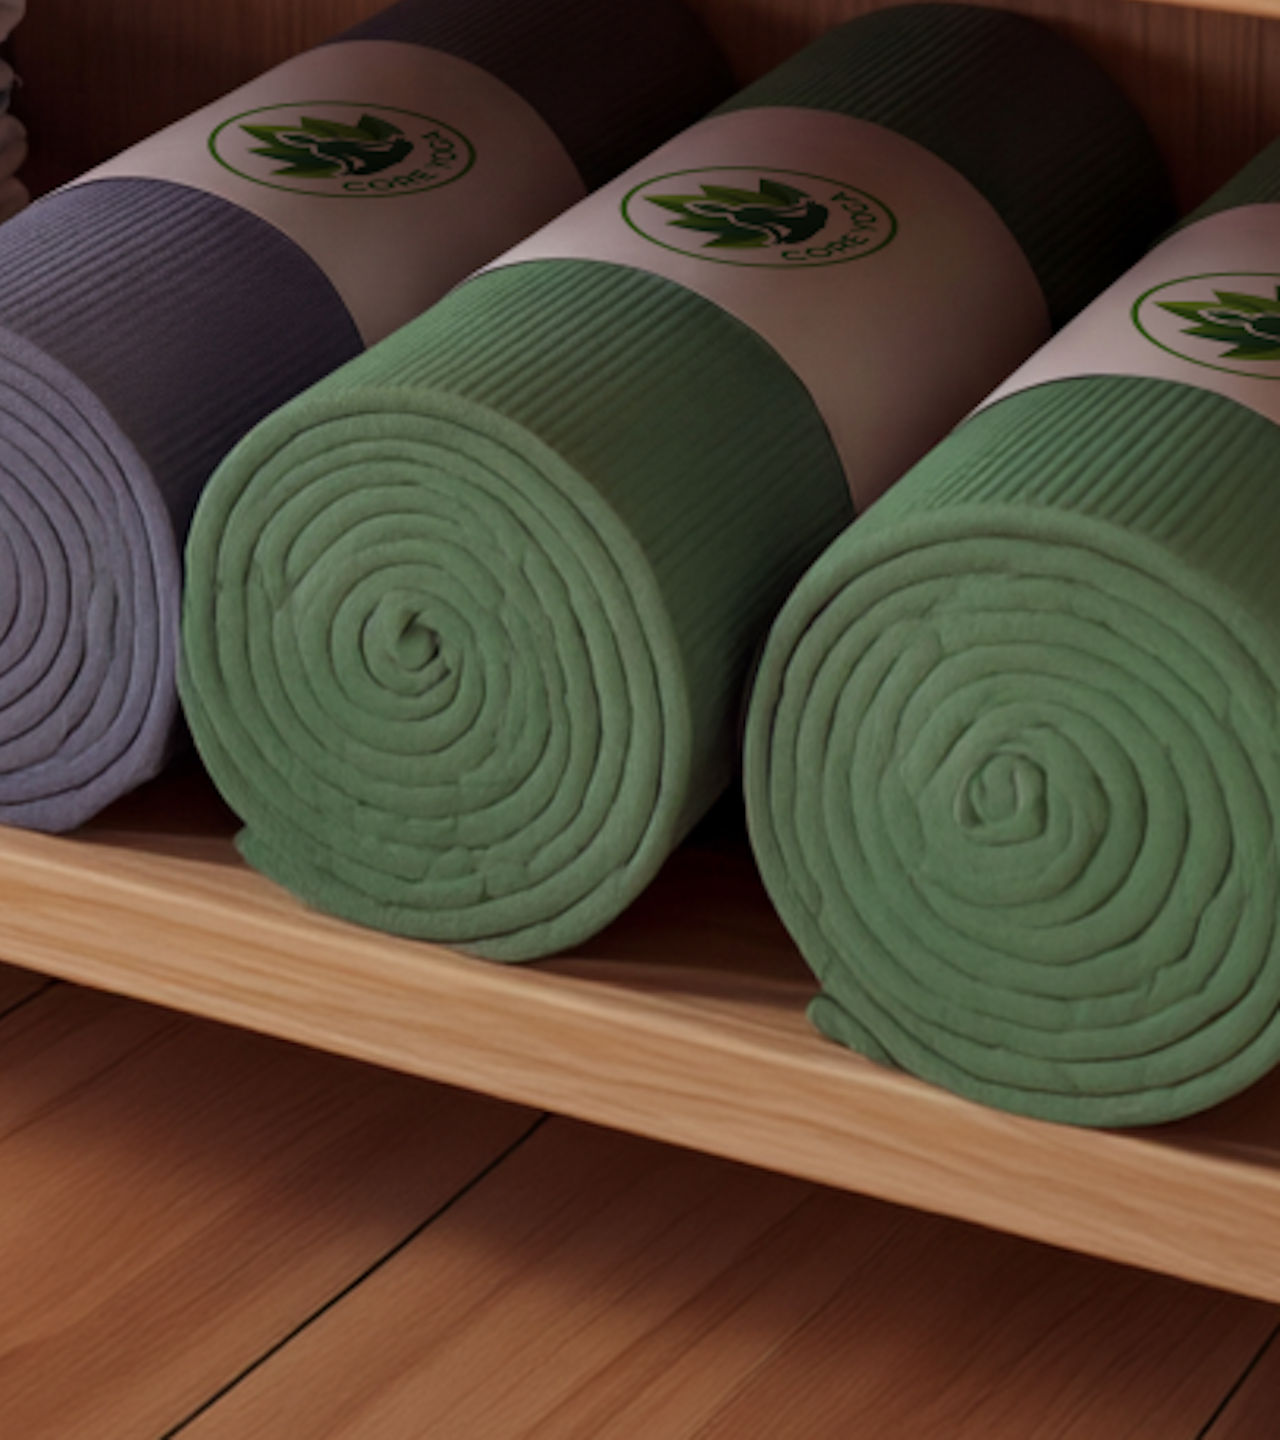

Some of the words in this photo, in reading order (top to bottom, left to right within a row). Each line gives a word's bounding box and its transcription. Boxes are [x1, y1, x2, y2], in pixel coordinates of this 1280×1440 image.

[342, 169, 439, 192] CORE
[781, 232, 870, 261] CORE
[830, 191, 877, 234] YOGA
